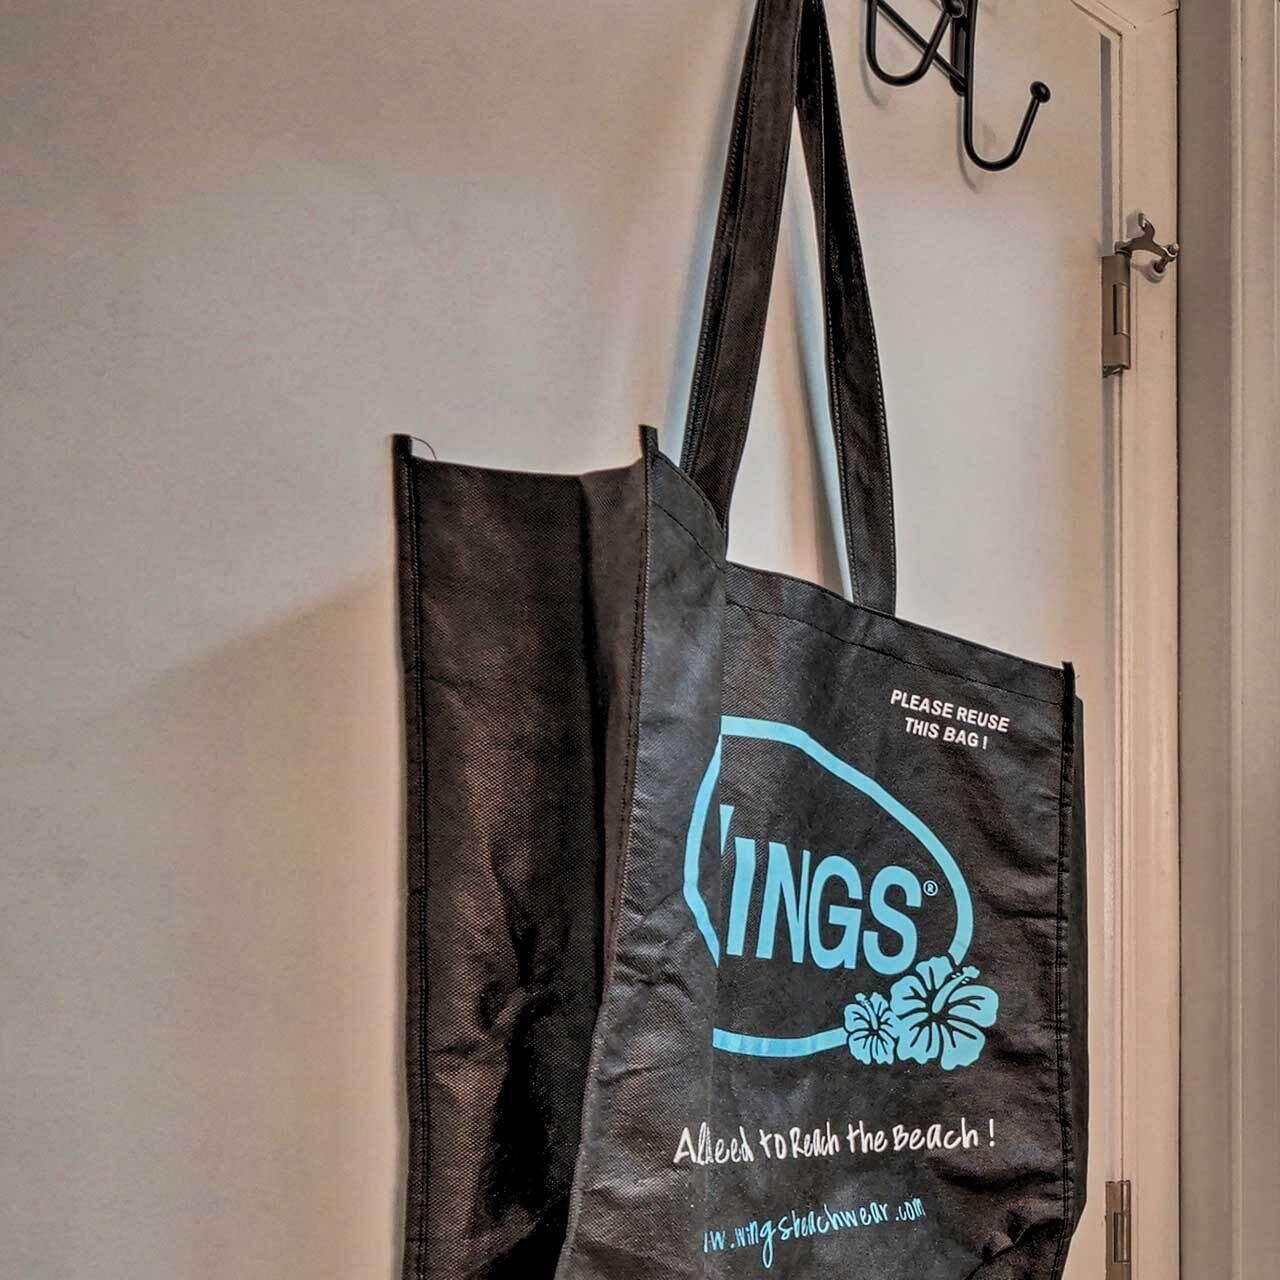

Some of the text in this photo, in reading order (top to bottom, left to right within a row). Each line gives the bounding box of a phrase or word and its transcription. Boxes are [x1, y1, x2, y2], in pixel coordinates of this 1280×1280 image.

[890, 689, 1010, 733] PLEASE REUSE
[905, 717, 940, 740] THIS
[942, 726, 979, 748] BAG
[846, 1119, 888, 1154] the
[892, 1116, 979, 1151] Beach
